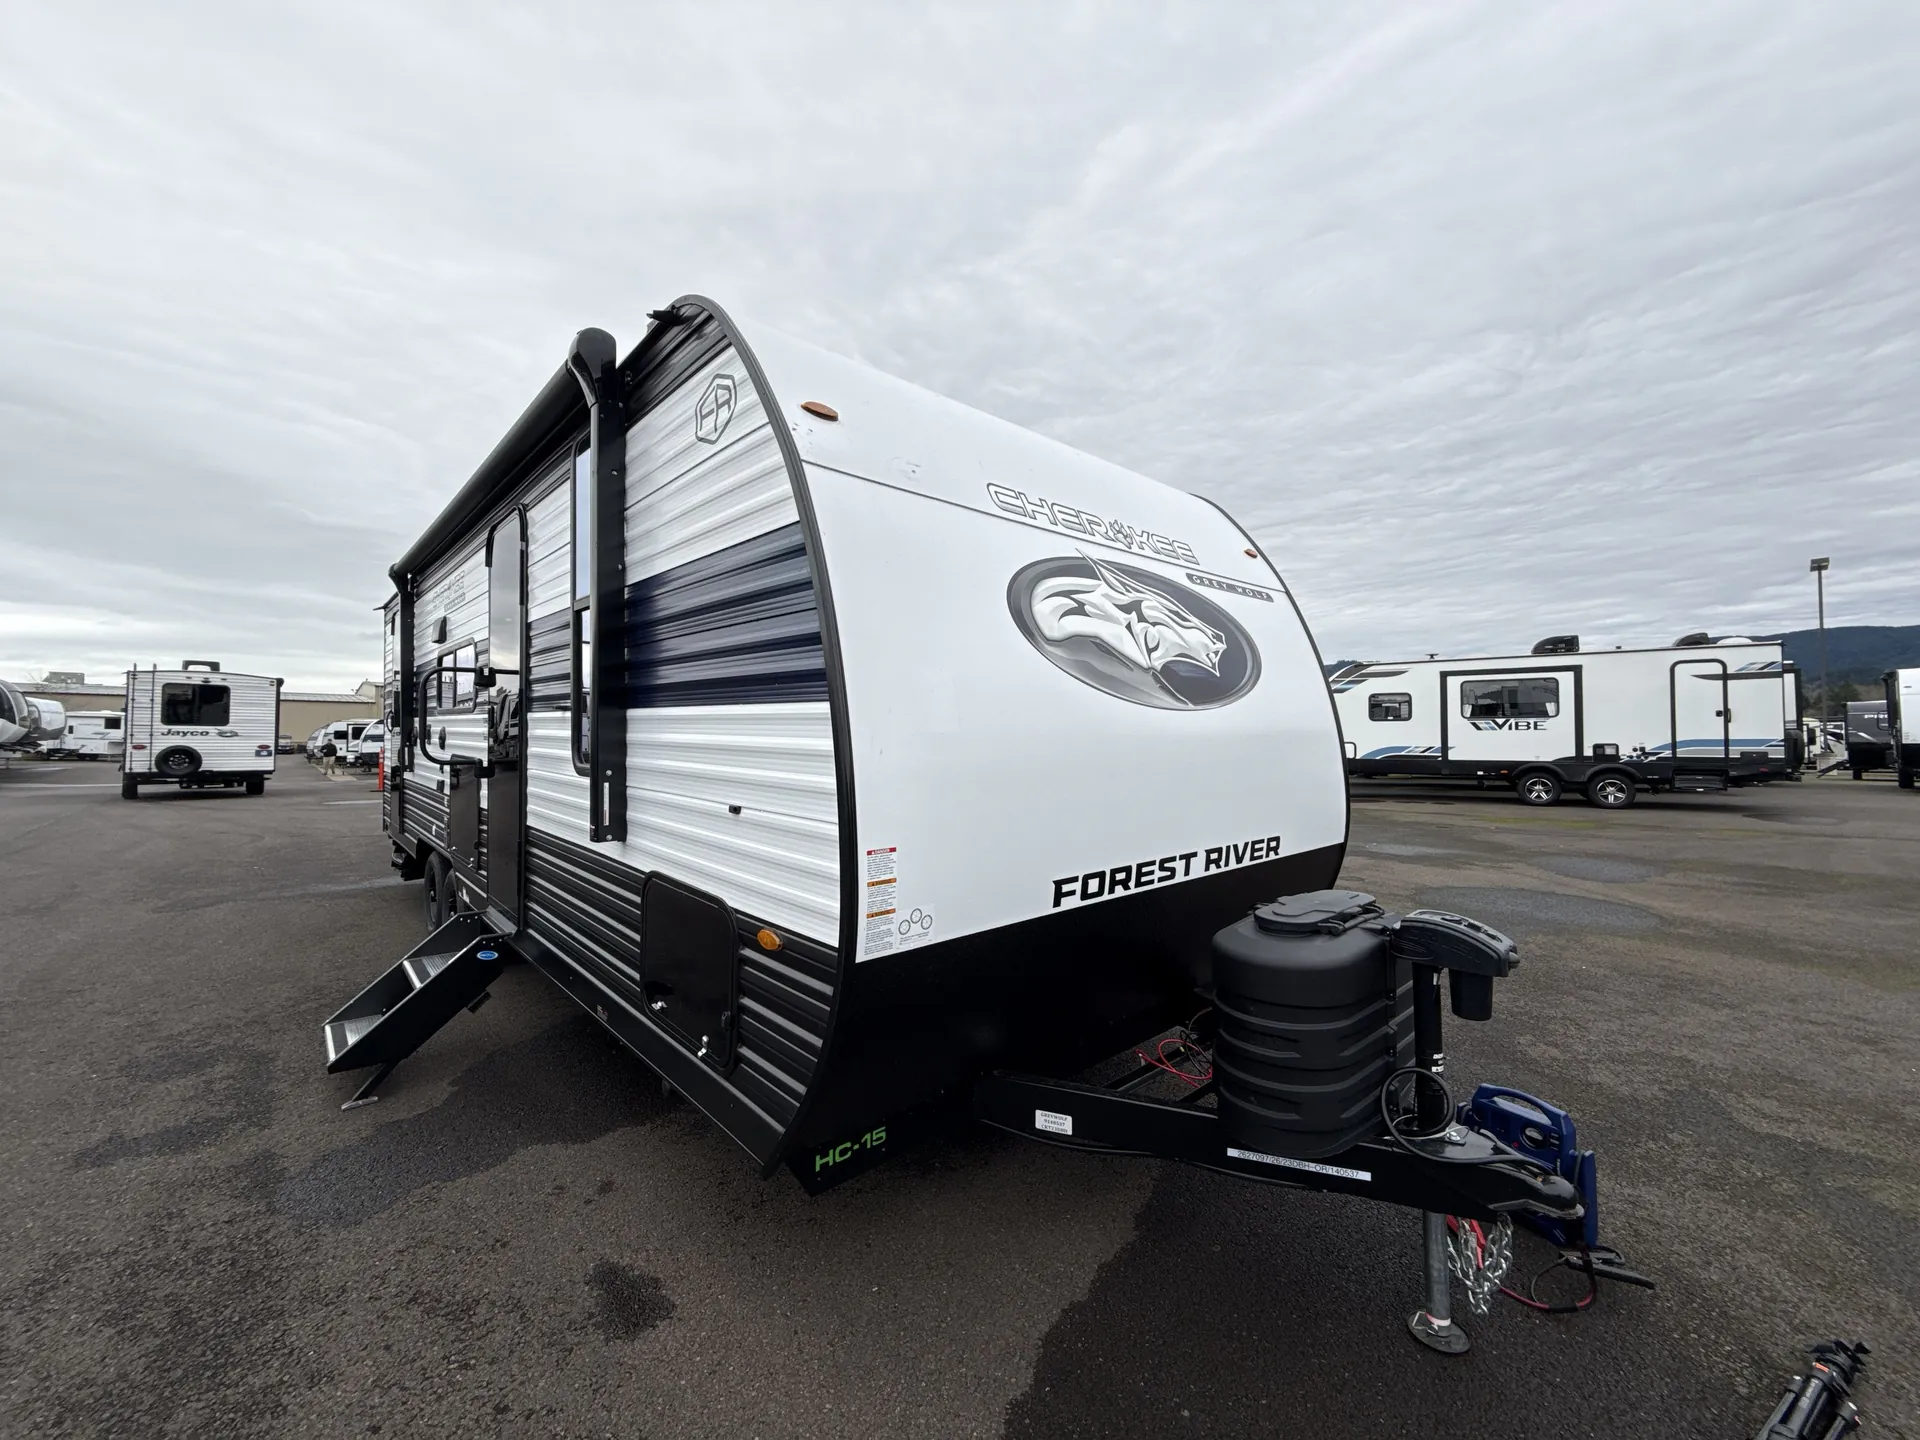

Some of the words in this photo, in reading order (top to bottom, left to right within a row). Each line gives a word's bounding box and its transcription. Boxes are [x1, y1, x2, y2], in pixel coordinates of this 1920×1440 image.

[1192, 575, 1228, 590] GREY
[1234, 585, 1268, 600] WOLF
[161, 729, 210, 737] Jayco
[1491, 718, 1548, 731] VIBE
[1052, 851, 1199, 909] FOREST
[1204, 835, 1282, 873] RIVER
[815, 1126, 887, 1173] HC-15
